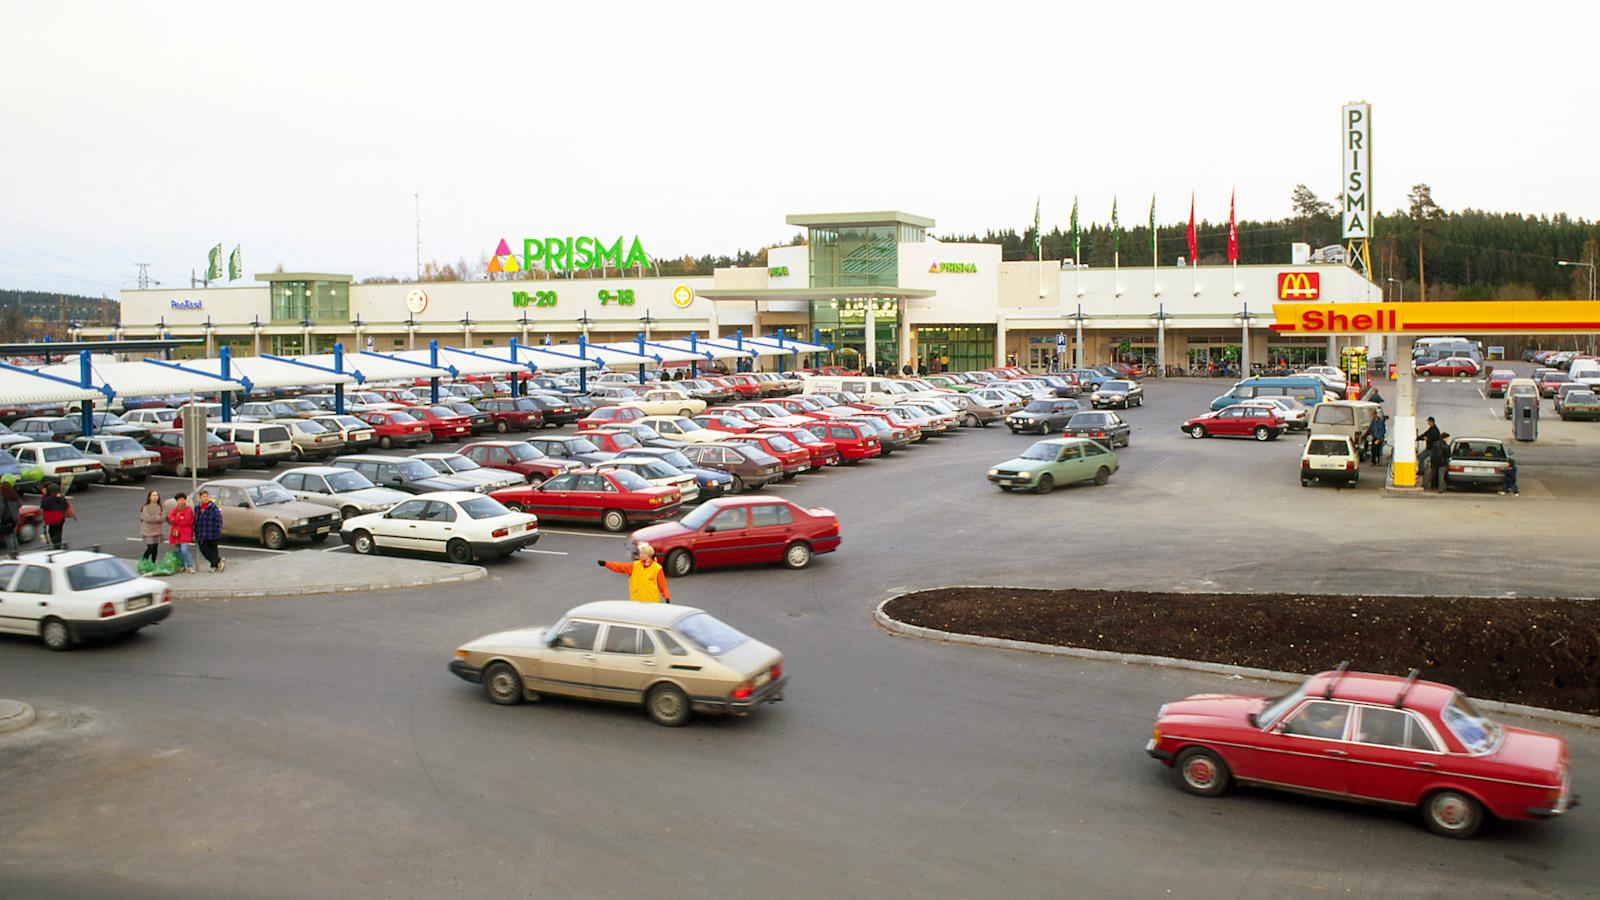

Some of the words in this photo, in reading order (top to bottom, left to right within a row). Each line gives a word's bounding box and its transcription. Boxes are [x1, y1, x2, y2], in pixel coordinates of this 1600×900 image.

[1346, 109, 1365, 232] PRISMA
[523, 234, 652, 271] PRISMA
[939, 262, 977, 273] PRISMA
[512, 290, 557, 307] 10-20
[598, 288, 635, 305] 9-18
[1301, 310, 1396, 331] Shell
